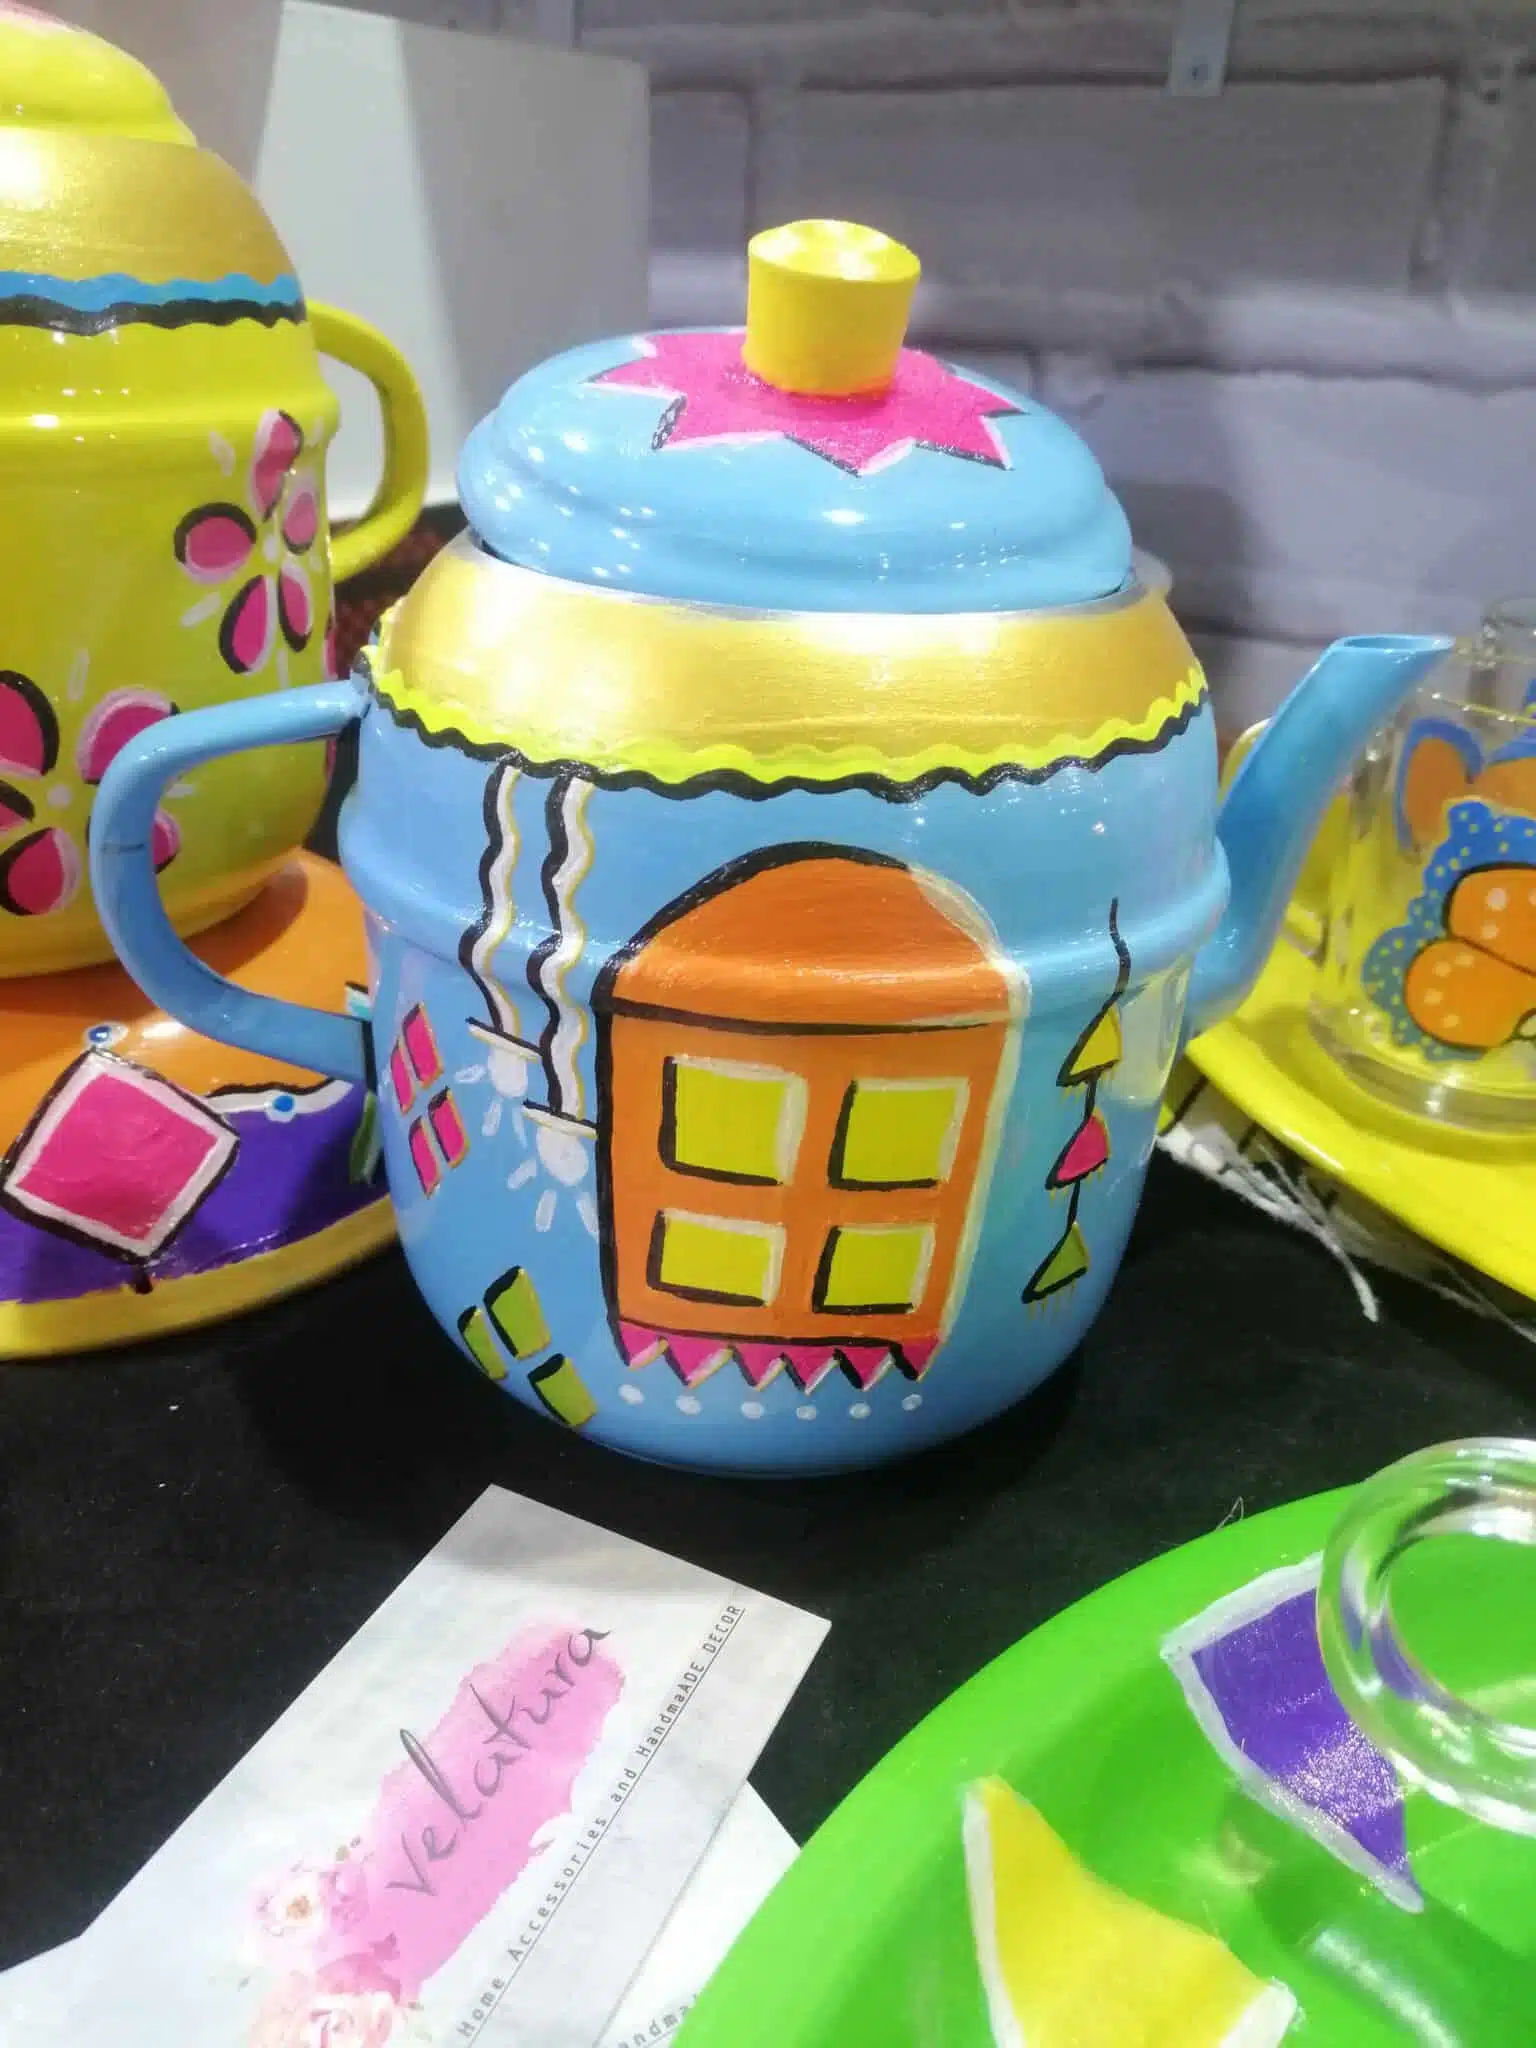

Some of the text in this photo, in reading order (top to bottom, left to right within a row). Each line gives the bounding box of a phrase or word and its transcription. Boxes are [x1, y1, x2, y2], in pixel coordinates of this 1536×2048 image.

[456, 1976, 506, 2039] Home
[506, 1816, 608, 1962] Accessories
[610, 1768, 638, 1803] and
[702, 1605, 741, 1654] DECOR
